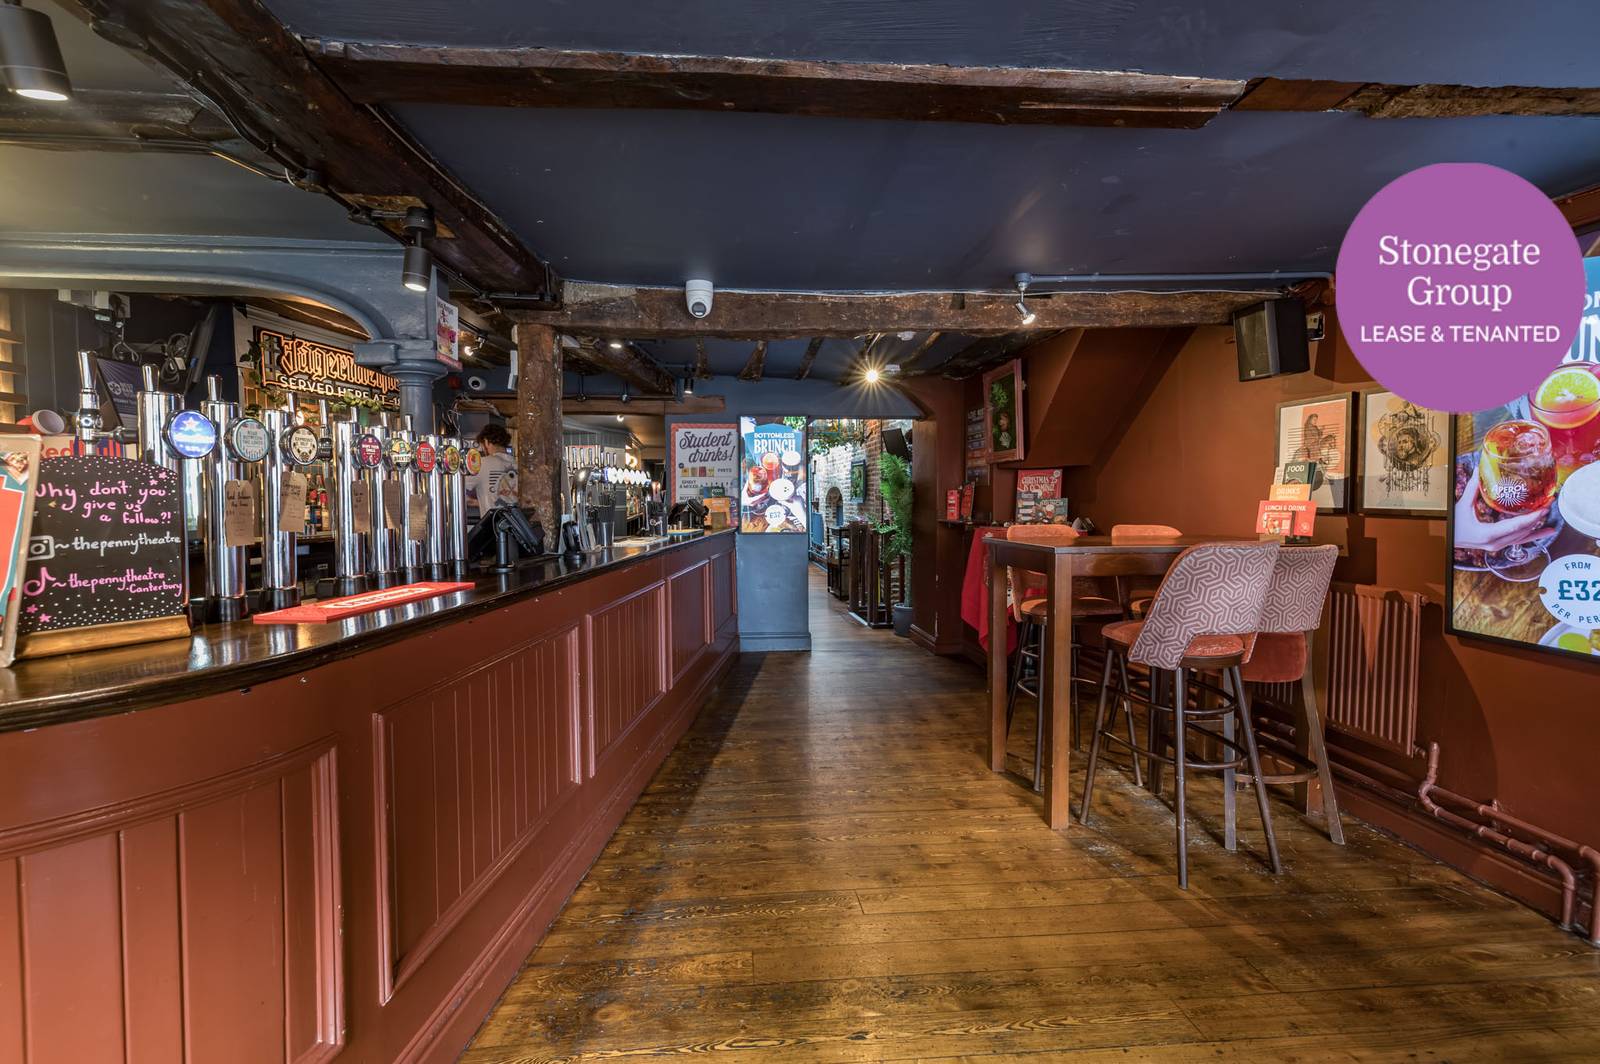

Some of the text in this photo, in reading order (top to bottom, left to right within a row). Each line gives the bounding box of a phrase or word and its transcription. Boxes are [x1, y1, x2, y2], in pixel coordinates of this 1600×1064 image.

[280, 376, 334, 396] SERVED
[680, 432, 732, 449] Student
[754, 438, 796, 454] BRUNCH
[688, 446, 736, 463] drinks!
[139, 487, 166, 504] you
[82, 500, 142, 518] give us
[1564, 561, 1592, 570] FROM
[1551, 603, 1572, 619] PER
